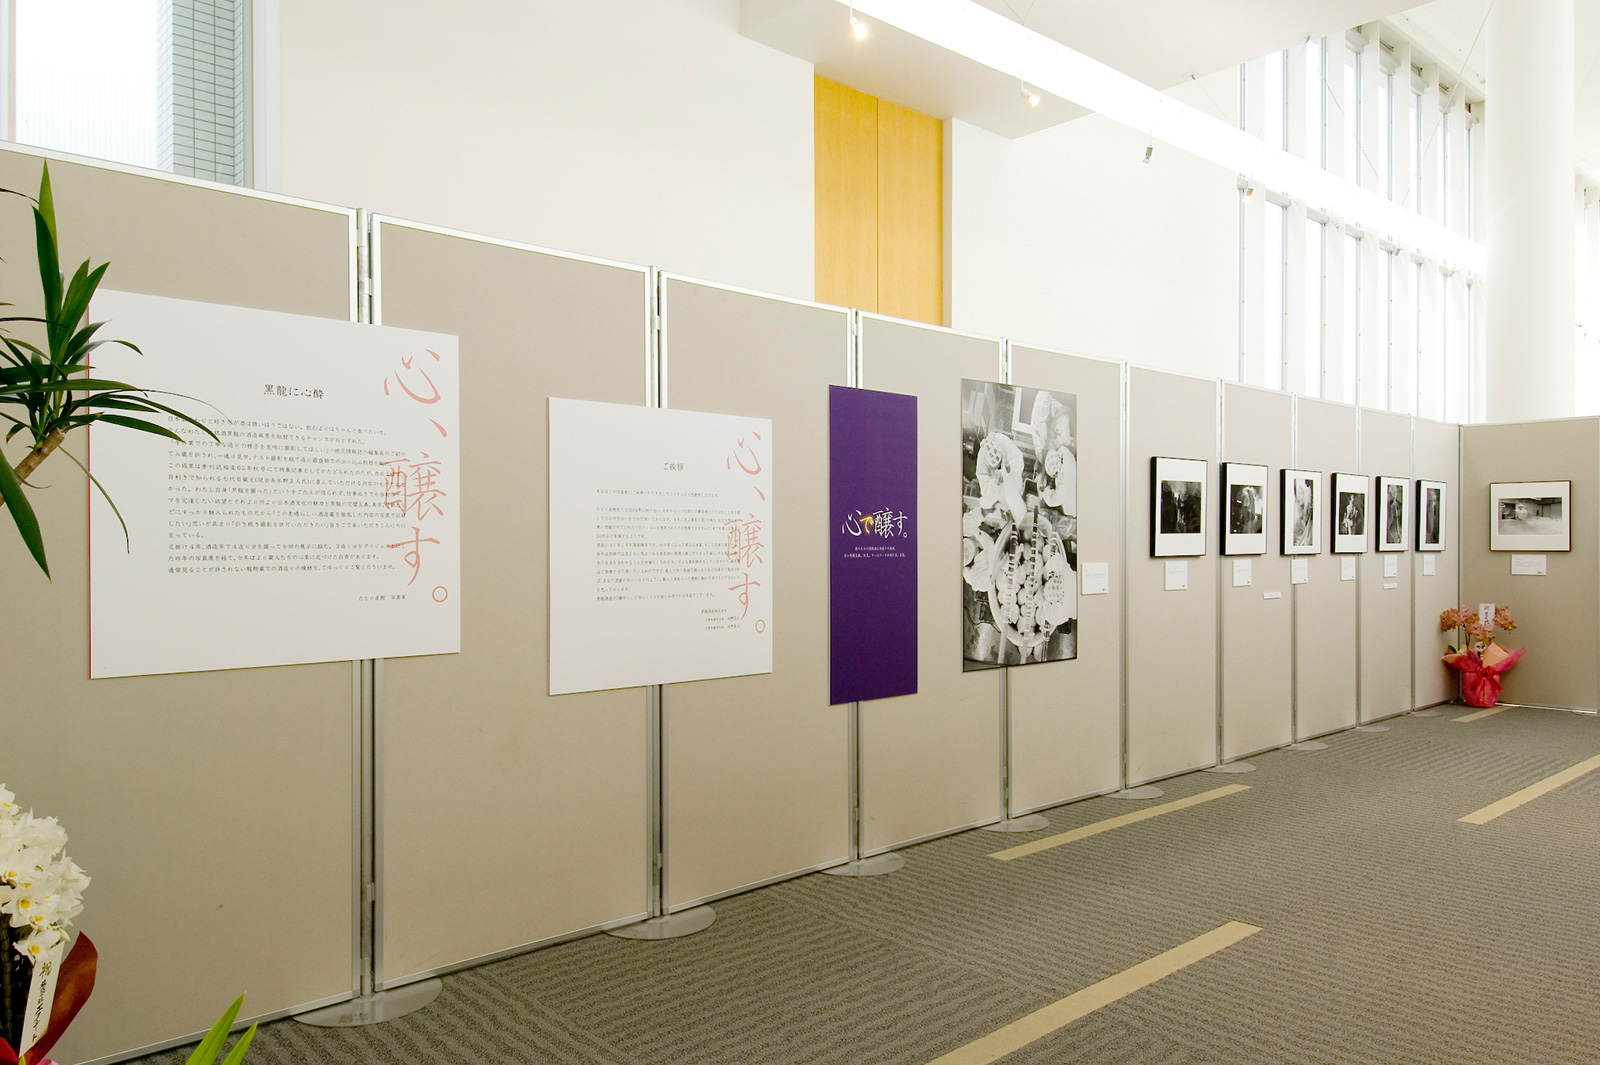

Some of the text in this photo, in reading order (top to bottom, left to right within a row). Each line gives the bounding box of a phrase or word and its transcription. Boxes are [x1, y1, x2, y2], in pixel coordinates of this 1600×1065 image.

[263, 383, 325, 400] 黒龍に心酔
[841, 507, 908, 539] 心で醸す。
